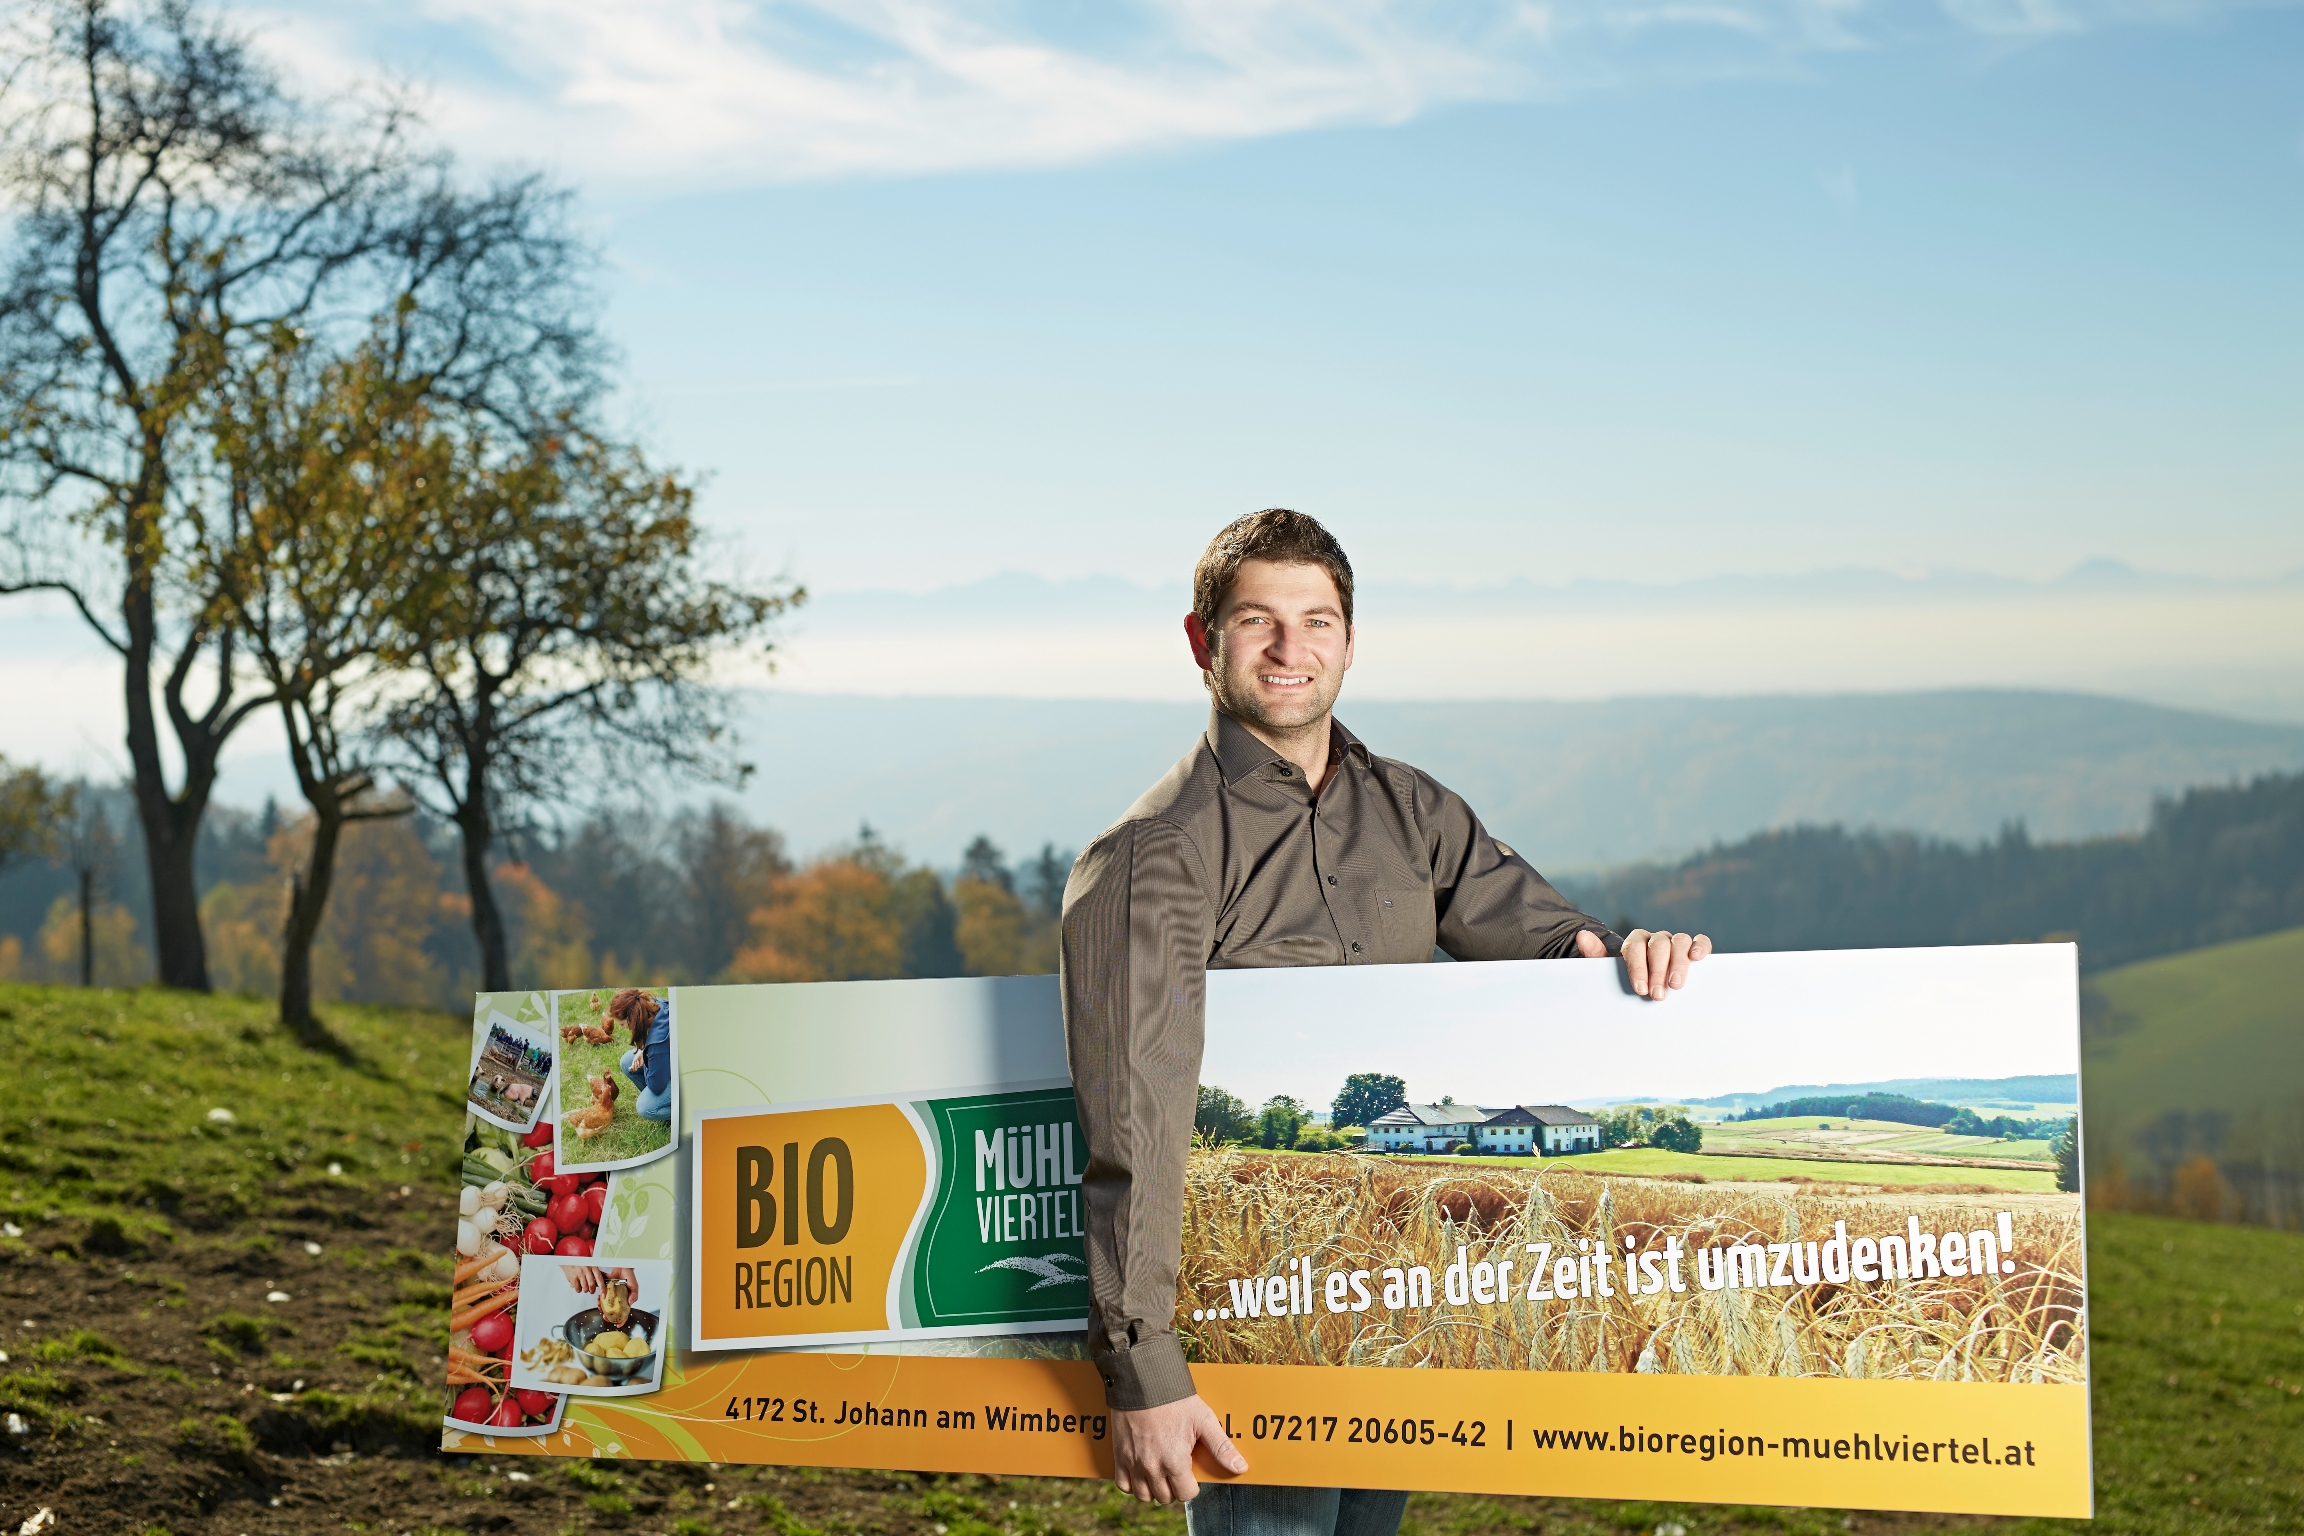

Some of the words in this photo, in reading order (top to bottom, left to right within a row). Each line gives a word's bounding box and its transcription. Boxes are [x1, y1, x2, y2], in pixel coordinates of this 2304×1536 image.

[975, 1121, 1083, 1192] MÜHL
[735, 1136, 854, 1249] BIO
[976, 1189, 1085, 1244] VIERTEL
[734, 1255, 852, 1310] REGION
[1325, 1269, 1372, 1314] es
[1381, 1265, 1434, 1311] an
[1443, 1244, 1514, 1307] der
[1524, 1236, 1616, 1302] Zeit
[1624, 1234, 1688, 1296] ist
[1696, 1210, 2017, 1292] umzudenken!
[725, 1396, 785, 1422] 4172
[792, 1398, 826, 1425] St.
[833, 1400, 927, 1428] Johann
[936, 1410, 976, 1430] am
[984, 1405, 1107, 1441] Wimberg
[1252, 1413, 1338, 1442] 07217
[1348, 1416, 1486, 1447] 20605-42
[1532, 1424, 2036, 1467] www.bioregion-muehlviertel.at
